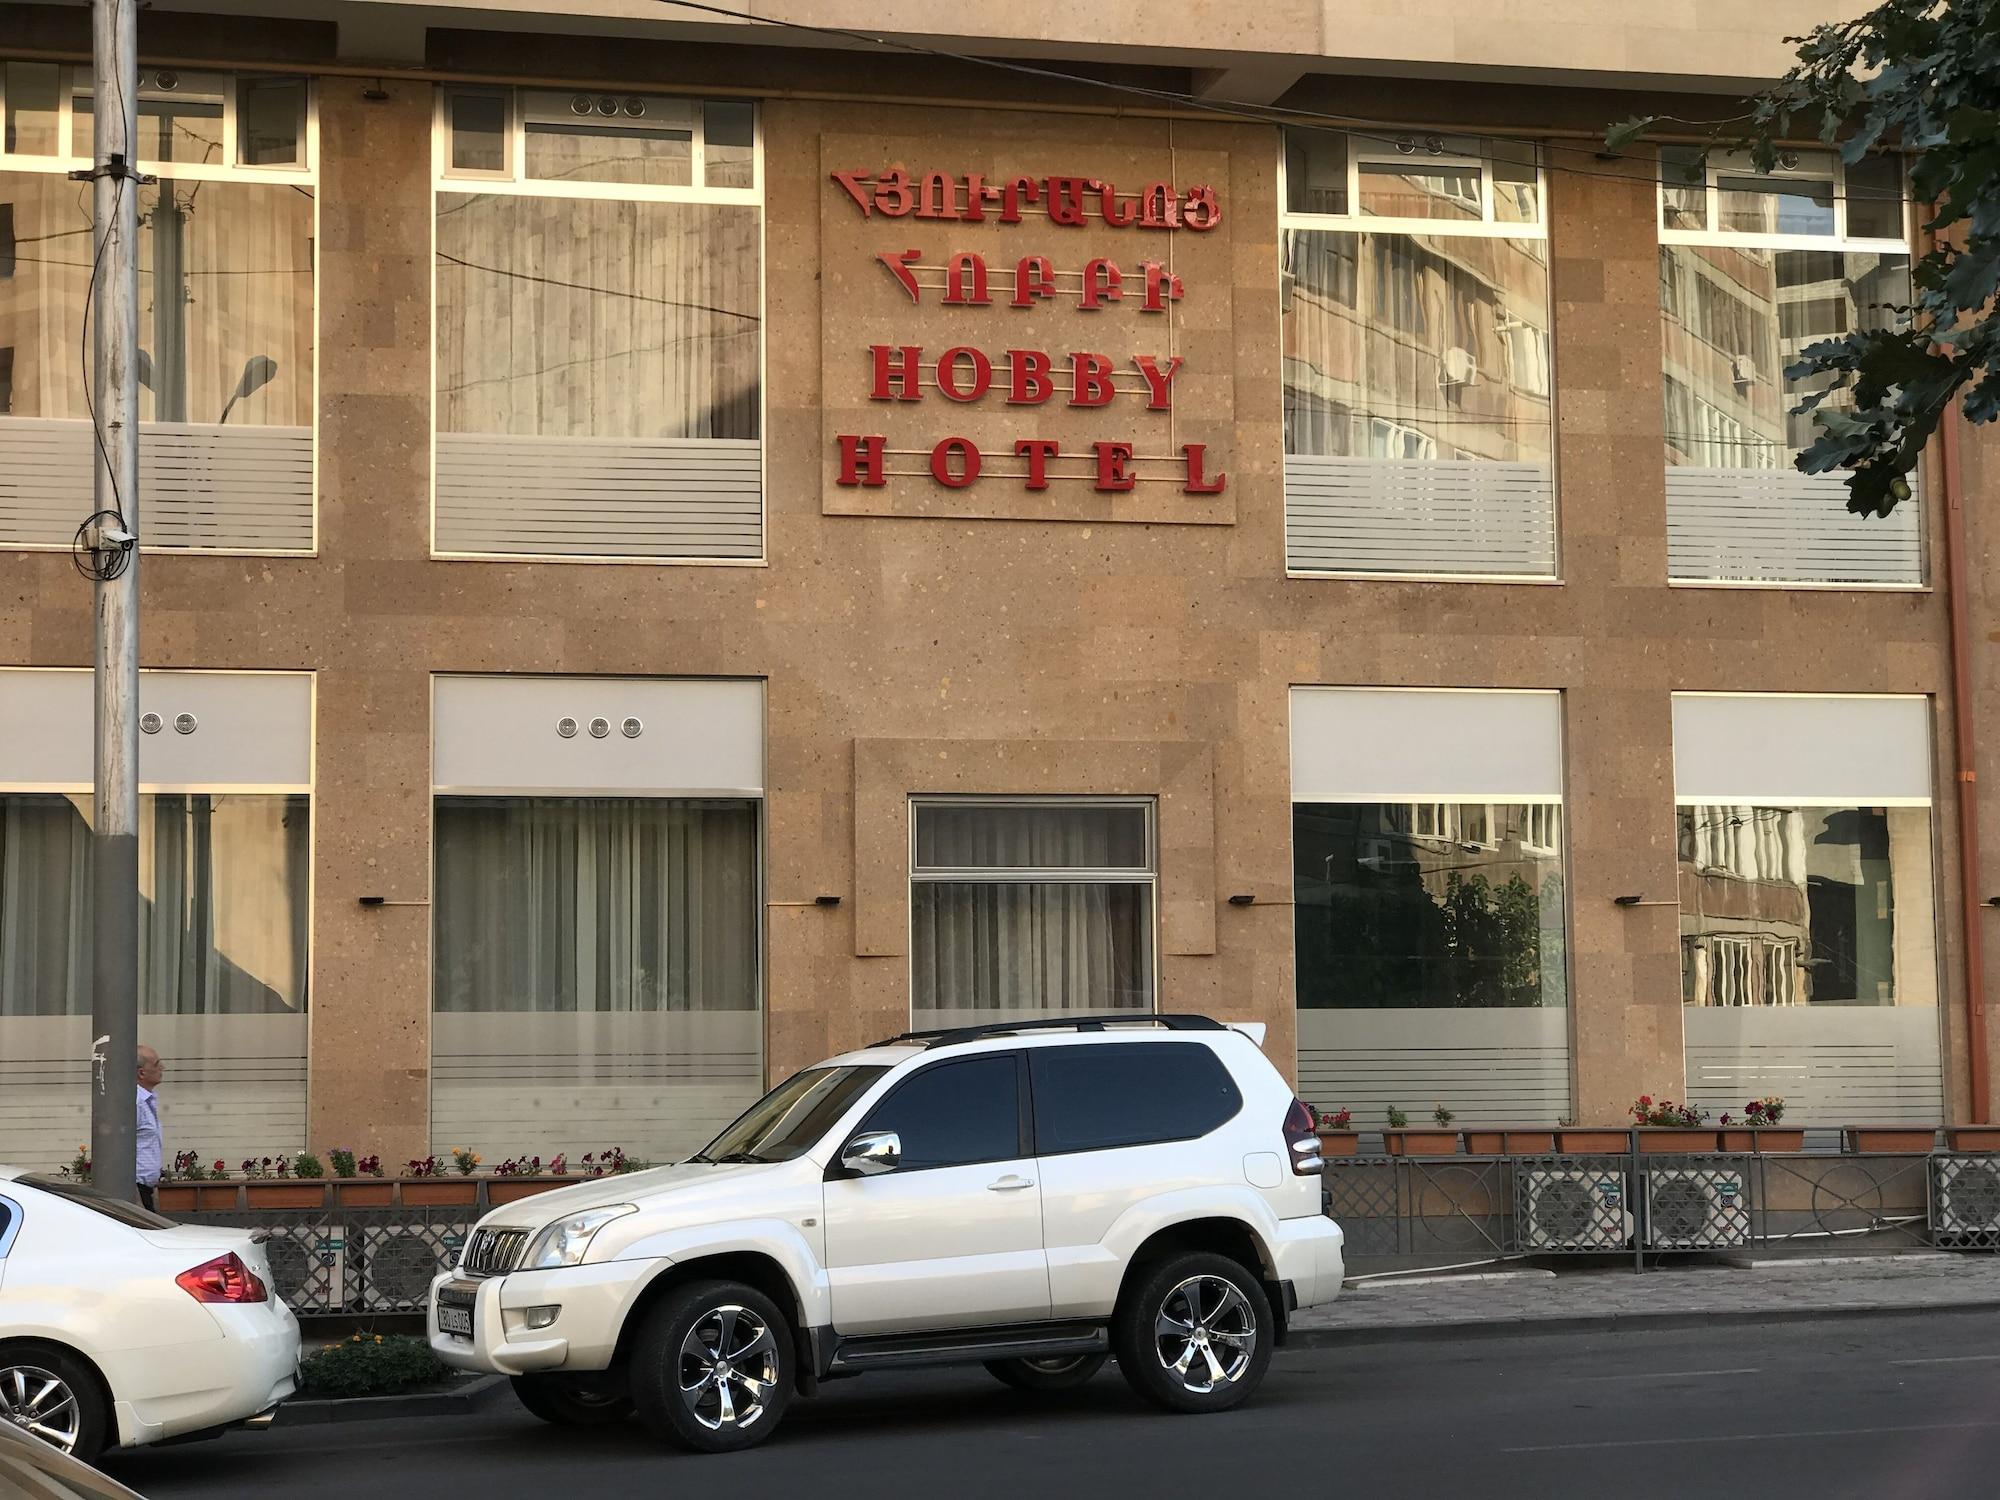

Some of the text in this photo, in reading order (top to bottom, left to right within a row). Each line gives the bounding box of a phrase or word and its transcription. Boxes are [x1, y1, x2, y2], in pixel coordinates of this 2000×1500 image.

[831, 168, 1222, 232] ՀՅՈՒՐԱՆՈՑ
[875, 249, 1185, 312] ՀՈԲԲԻ
[869, 345, 1185, 409] HOBBY
[836, 434, 1226, 494] HOTEL
